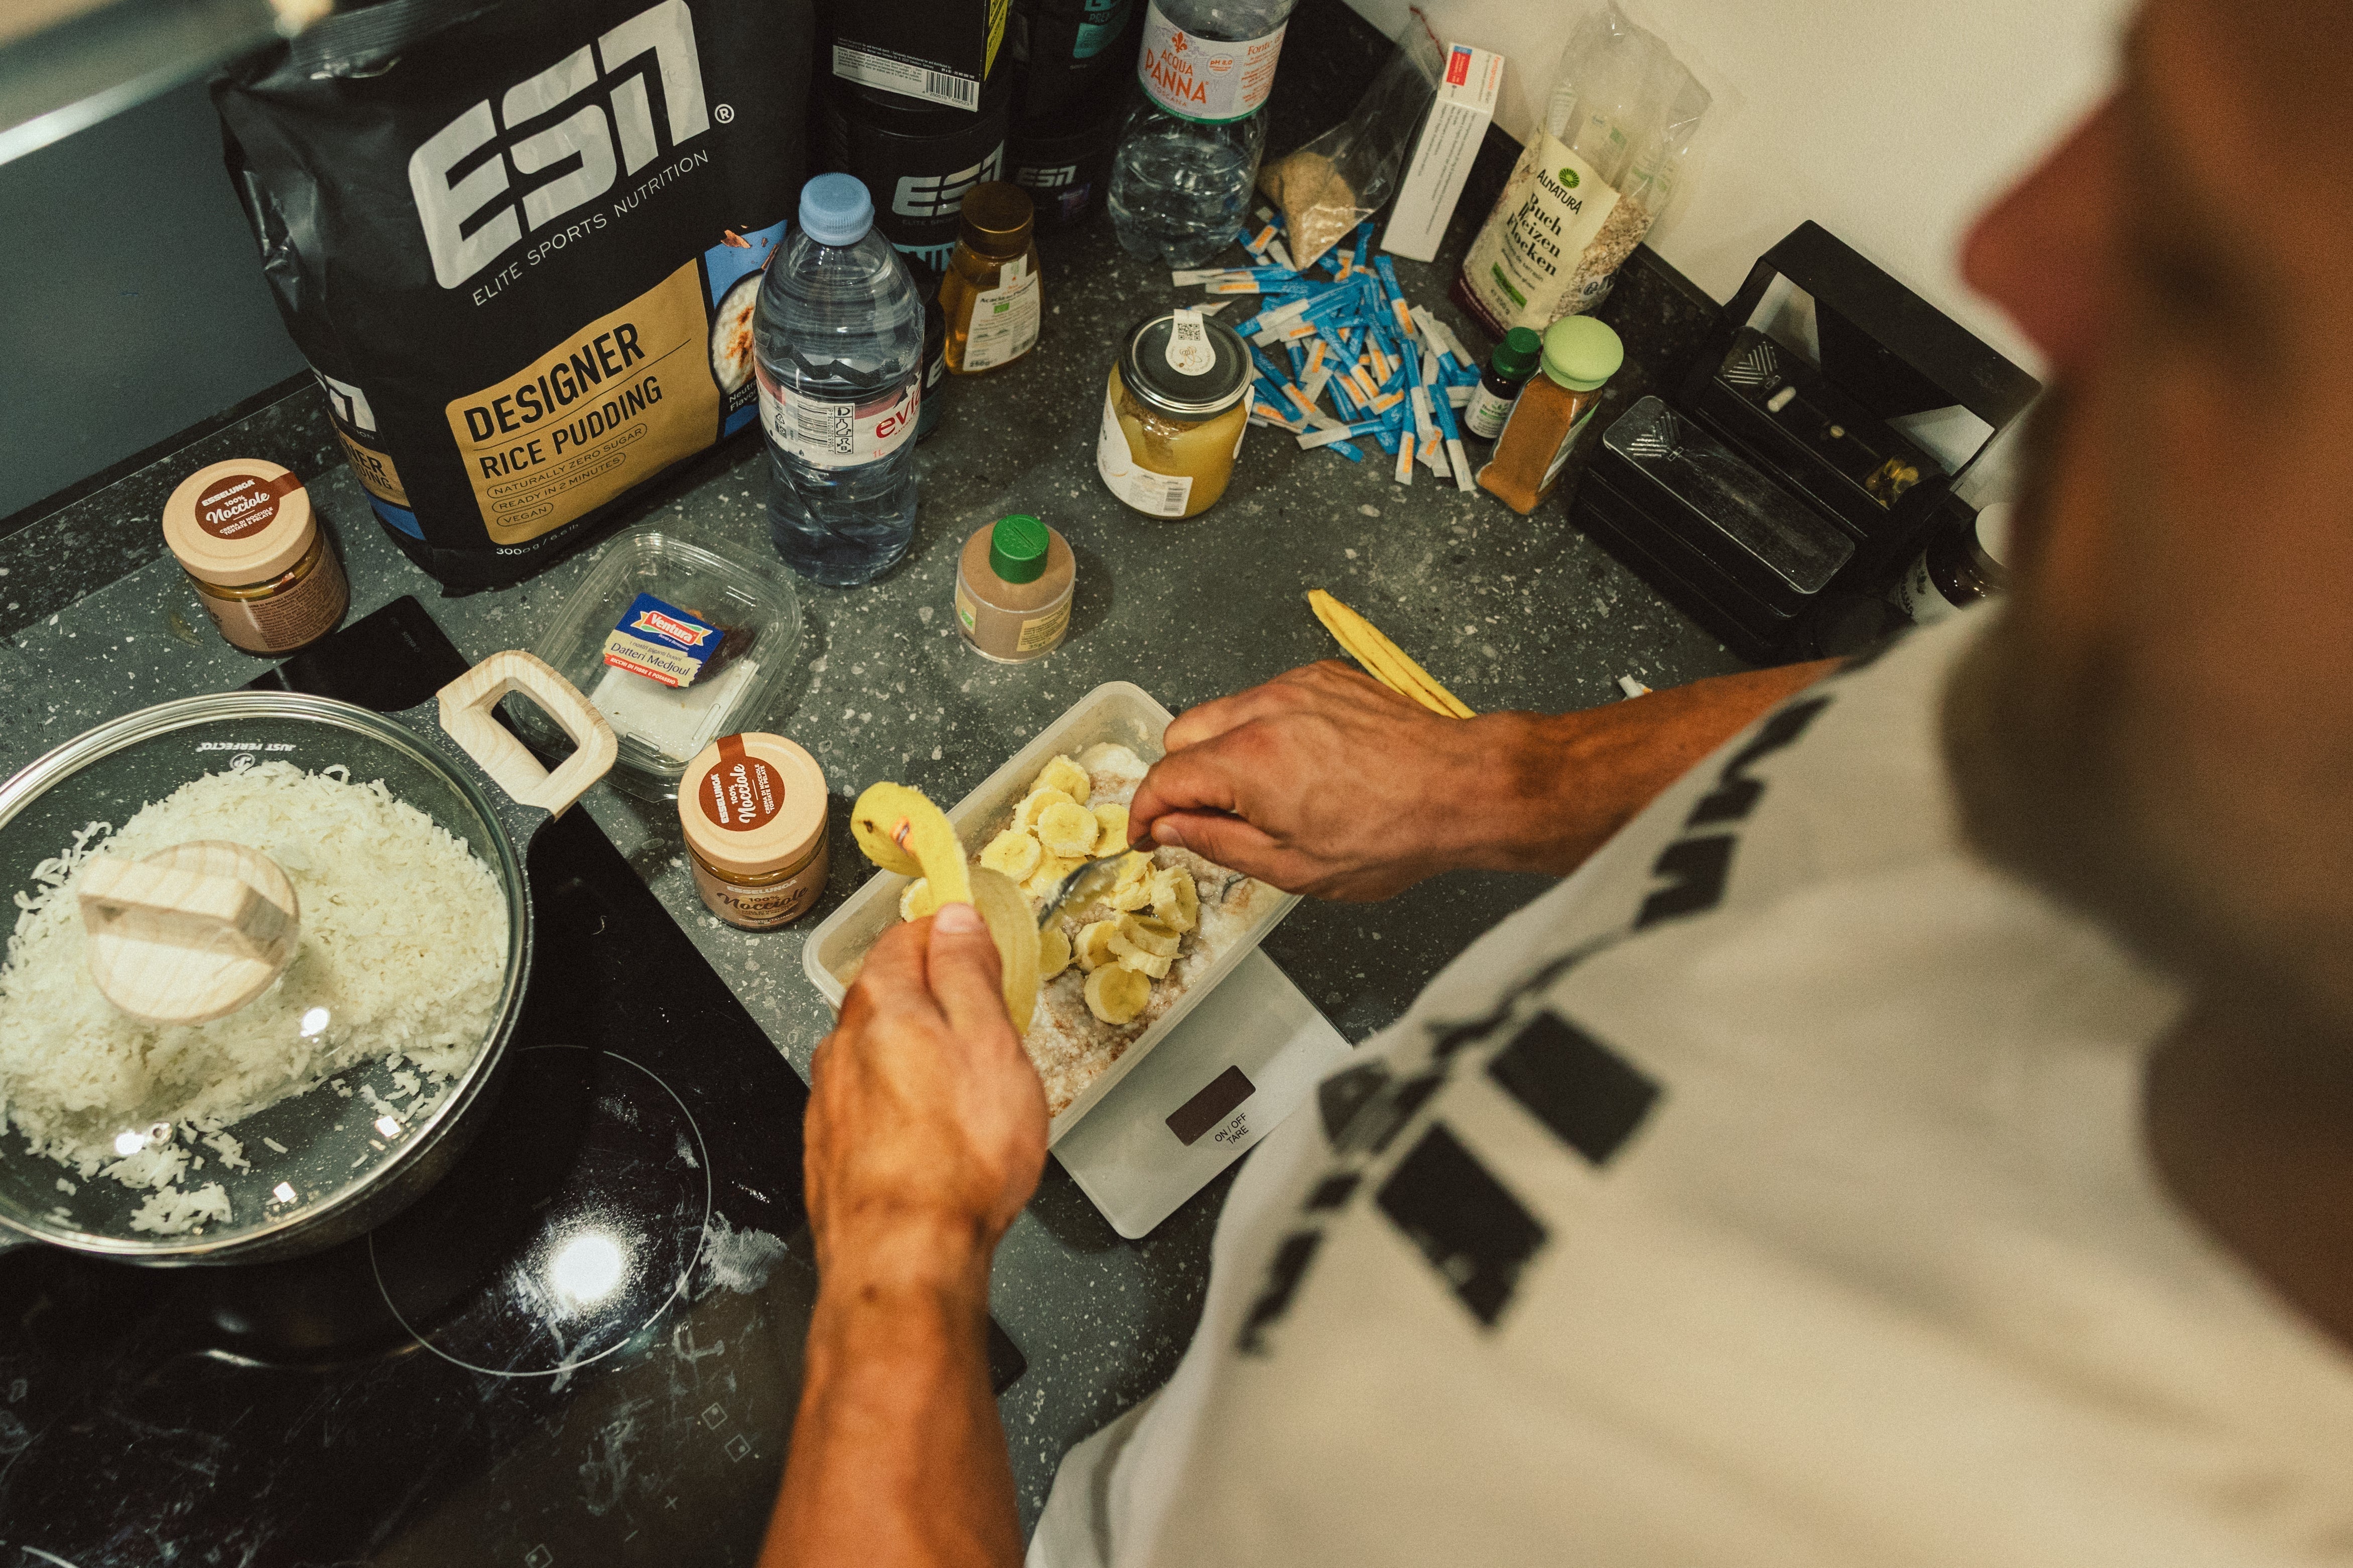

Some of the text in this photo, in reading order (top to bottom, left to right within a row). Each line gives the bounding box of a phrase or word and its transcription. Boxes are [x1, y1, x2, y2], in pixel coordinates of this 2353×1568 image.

[1145, 48, 1206, 104] PANNA
[1161, 49, 1193, 76] ACQUA
[408, 0, 710, 290] ESN
[1536, 169, 1583, 215] ALNATURA
[472, 150, 709, 306] ELITE SPORTS NUTRITION
[1527, 193, 1562, 236] Buch
[1507, 211, 1557, 276] Flocken
[1518, 201, 1561, 259] Weizen
[463, 323, 645, 443] DESIGNER
[479, 376, 663, 479] RICE PUDDING
[494, 427, 642, 495] NATURALLY ZERO SUGAR
[202, 479, 255, 506] ESSELUNGA
[499, 492, 541, 510] READY
[545, 486, 556, 496] IN
[569, 457, 620, 485] MINUTES
[206, 492, 270, 524] Nocciole
[224, 495, 245, 507] 100%
[220, 523, 239, 533] CREMA
[245, 507, 274, 522] NOCCIOLE
[224, 523, 248, 535] TOSTATE
[252, 511, 273, 523] PELATE
[503, 507, 547, 523] VEGAN
[496, 547, 530, 555] 3000
[650, 614, 693, 642] Ventura
[611, 643, 691, 676] Datteri Medjoul
[633, 642, 648, 650] nostri
[648, 646, 666, 656] giganti
[667, 652, 682, 661] buoni
[610, 657, 627, 667] RICCHI
[633, 666, 648, 674] FIBRE
[652, 672, 676, 684] POTASSIO
[202, 742, 296, 751] JUST PERFECTO
[754, 764, 765, 790] NOCCIOLE
[759, 765, 768, 784] PELATE
[711, 773, 729, 823] ESSELUNGA
[728, 785, 738, 804] 100%
[730, 764, 756, 823] Nocciole
[762, 796, 771, 814] CREMA
[765, 789, 774, 810] TOSTATE
[717, 887, 809, 911] Nocciole
[727, 879, 797, 894] ESSELUNGA
[769, 912, 794, 922] ITALIANO
[1215, 1129, 1229, 1142] ON
[1231, 1112, 1246, 1128] OFF
[1226, 1125, 1249, 1145] TARE
